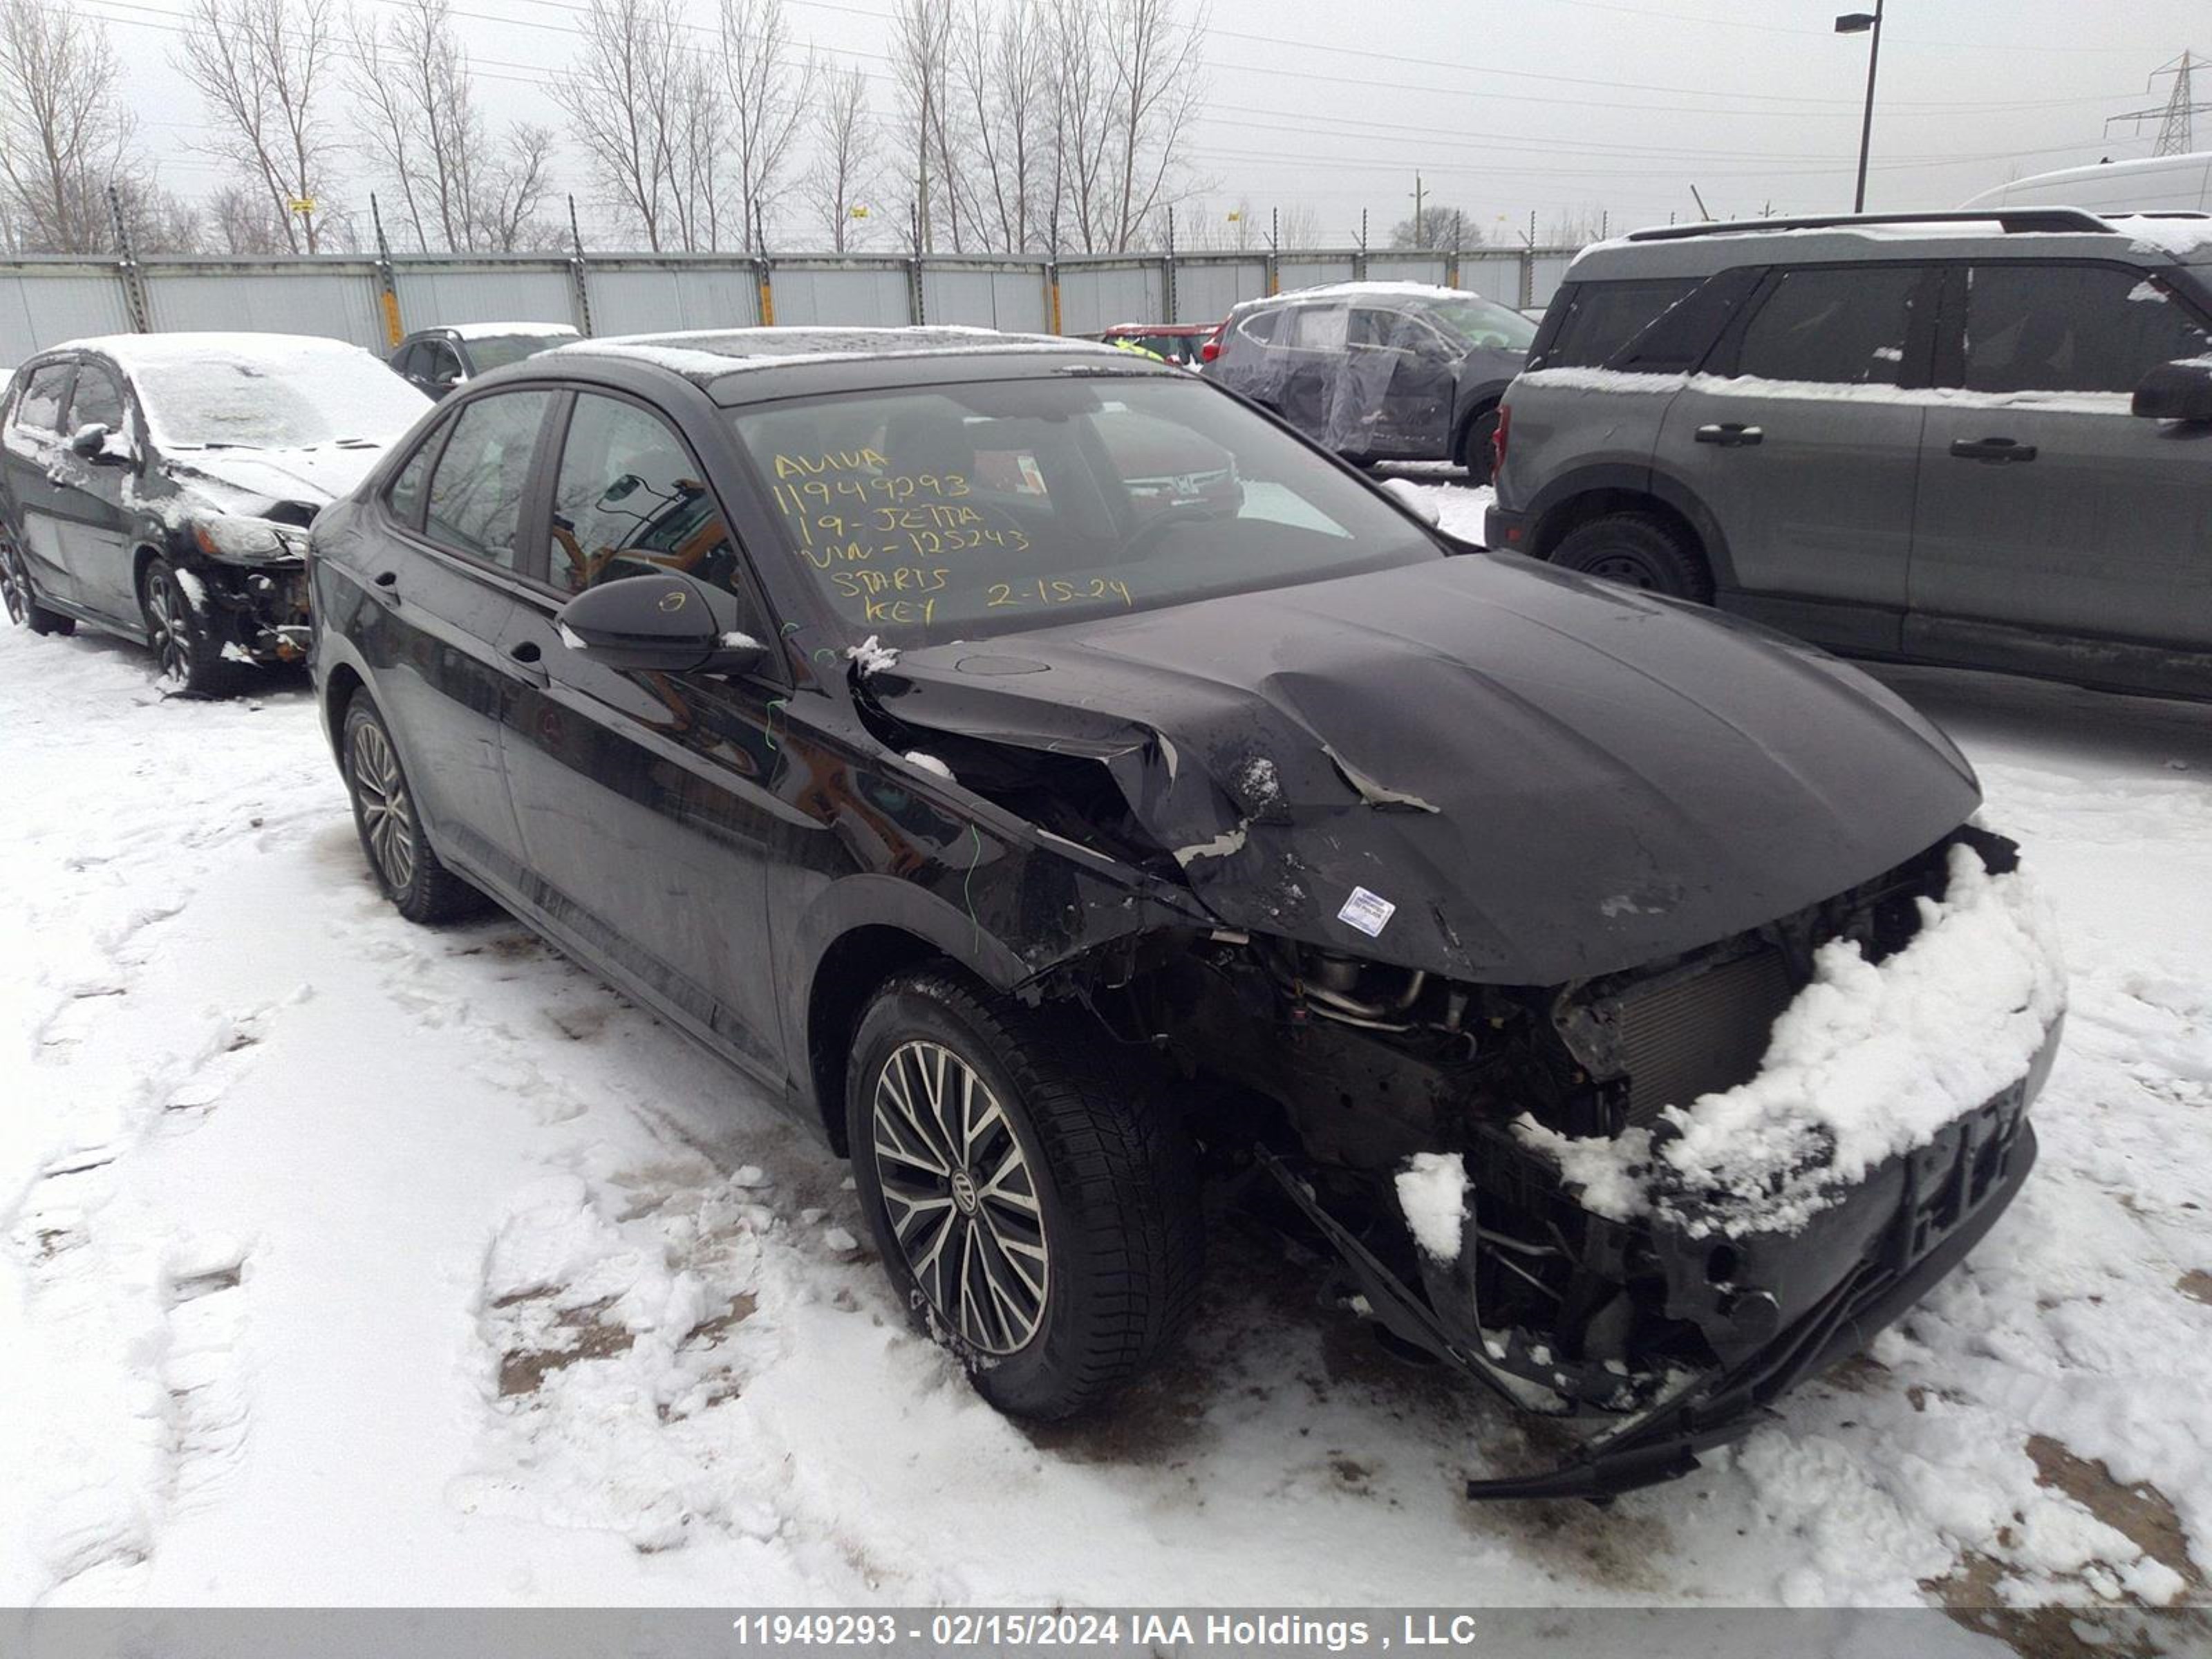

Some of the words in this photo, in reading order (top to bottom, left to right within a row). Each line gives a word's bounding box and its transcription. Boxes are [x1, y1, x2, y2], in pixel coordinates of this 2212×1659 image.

[774, 448, 889, 479] AVIVA
[773, 475, 970, 514] 11949293
[830, 568, 950, 597] STARTS
[864, 596, 935, 627] KEY
